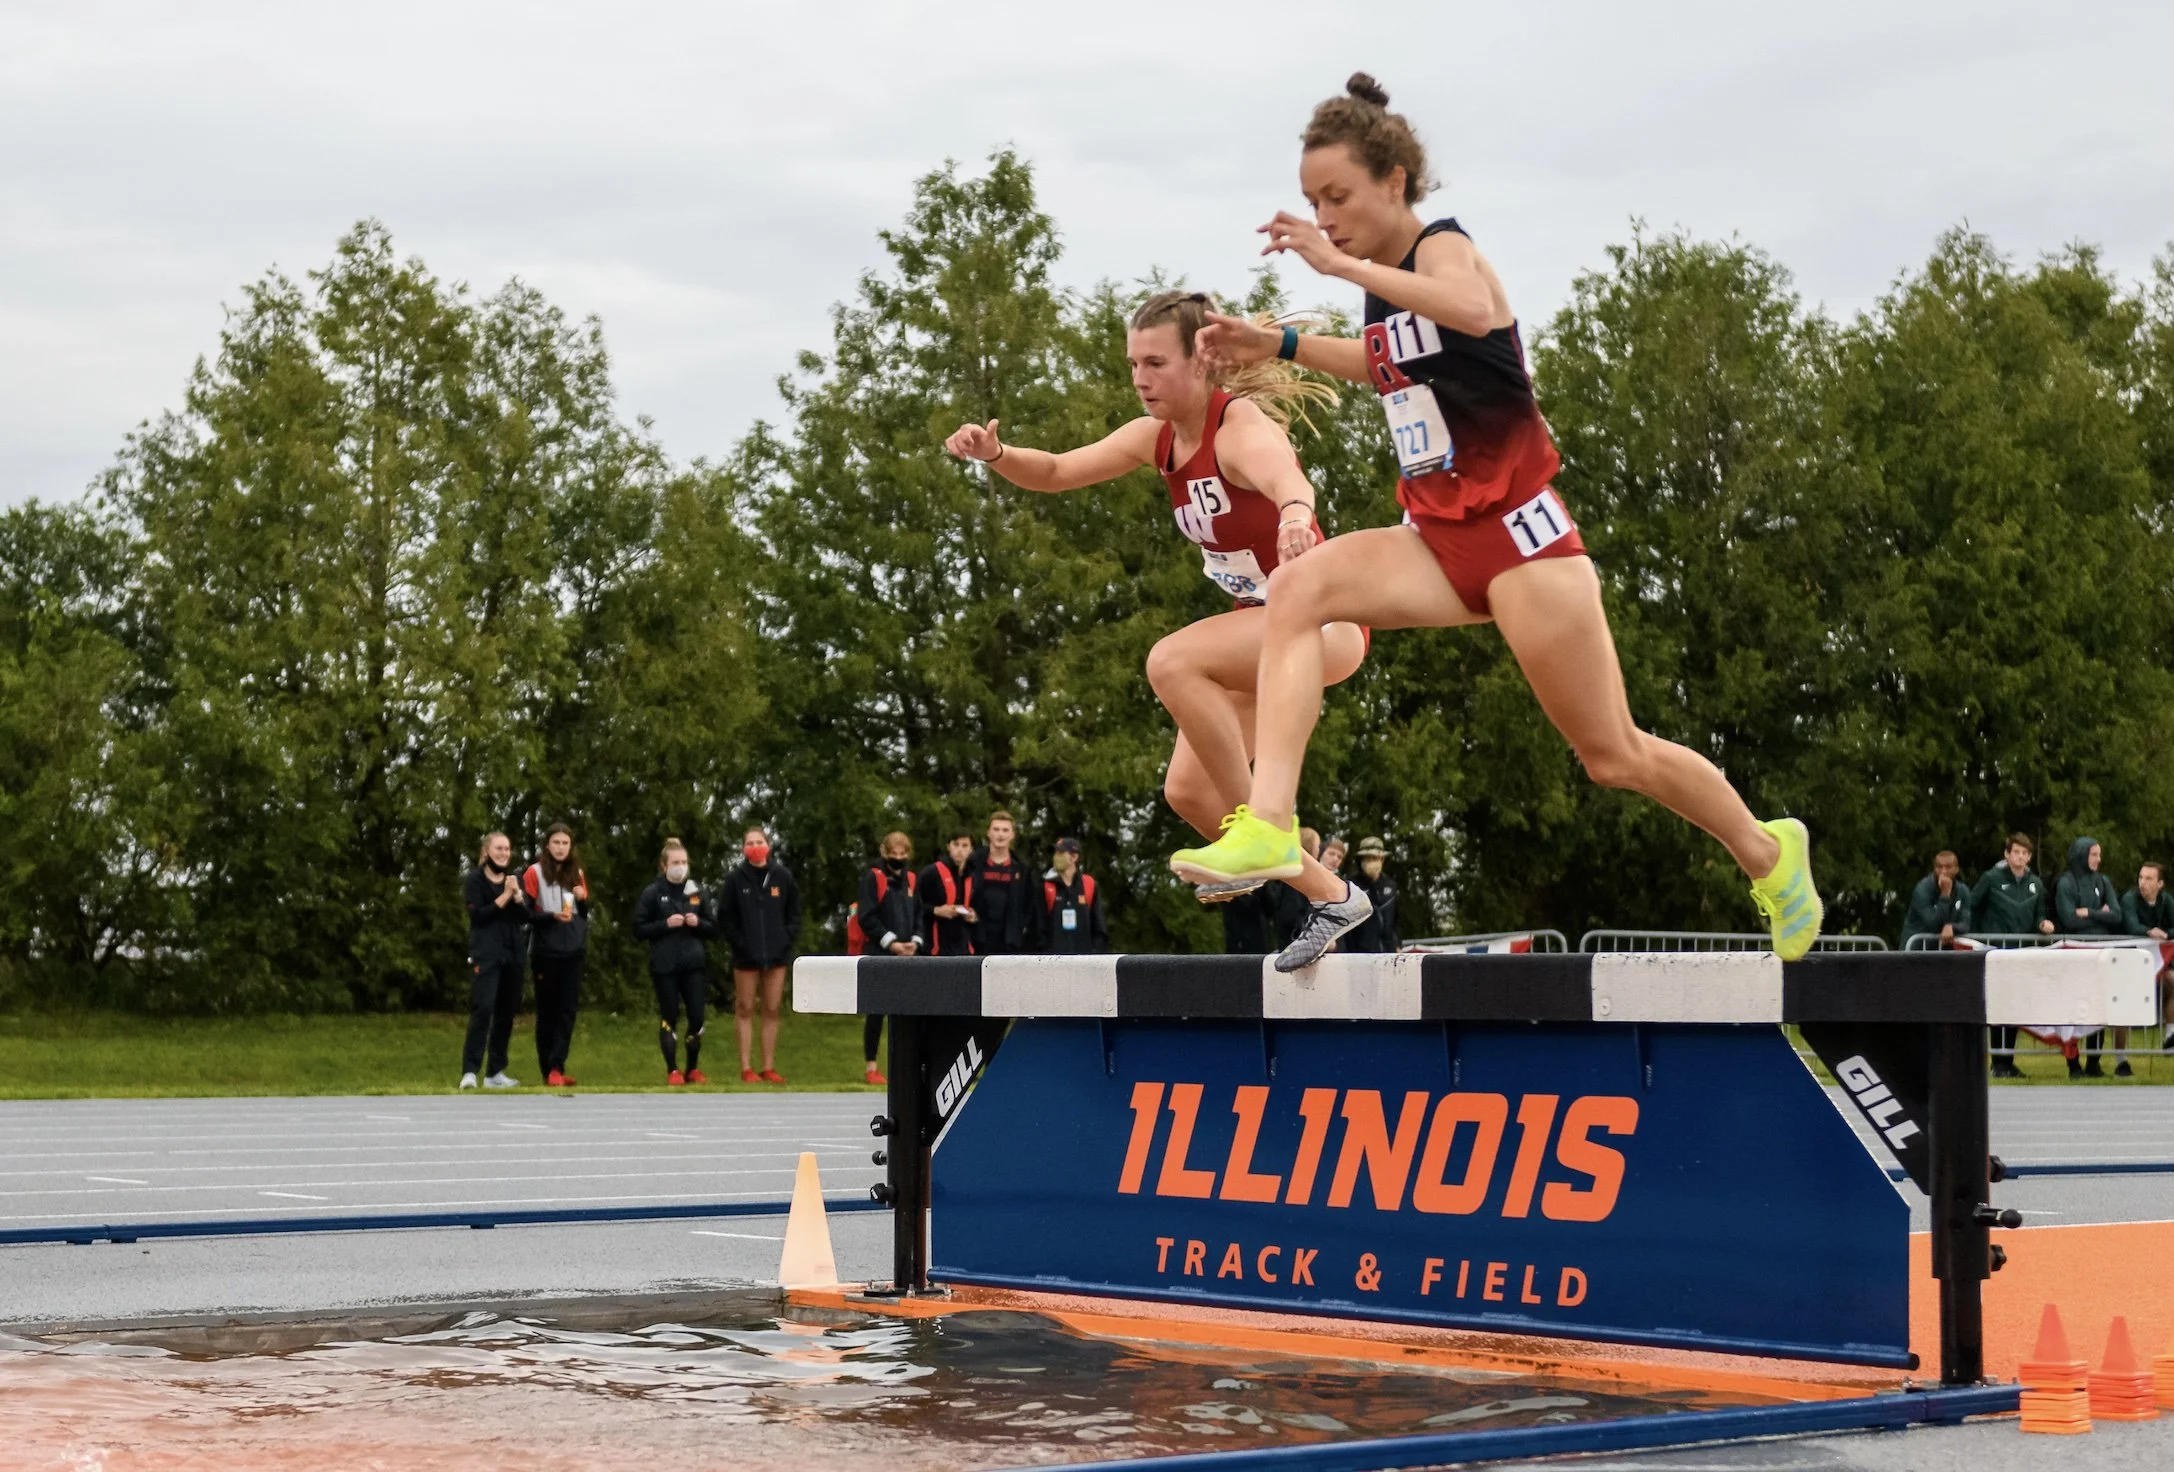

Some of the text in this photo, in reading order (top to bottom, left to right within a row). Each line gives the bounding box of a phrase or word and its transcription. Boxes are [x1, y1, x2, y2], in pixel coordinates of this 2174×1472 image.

[1390, 313, 1425, 358] 11
[1396, 420, 1429, 457] 727
[1193, 479, 1222, 515] 15
[1512, 499, 1560, 549] 11
[935, 1035, 983, 1118] GILL
[1836, 1055, 1922, 1150] GILL
[1118, 1082, 1640, 1223] ILLINOIS
[1156, 1237, 1588, 1307] TRACK & FIELD
